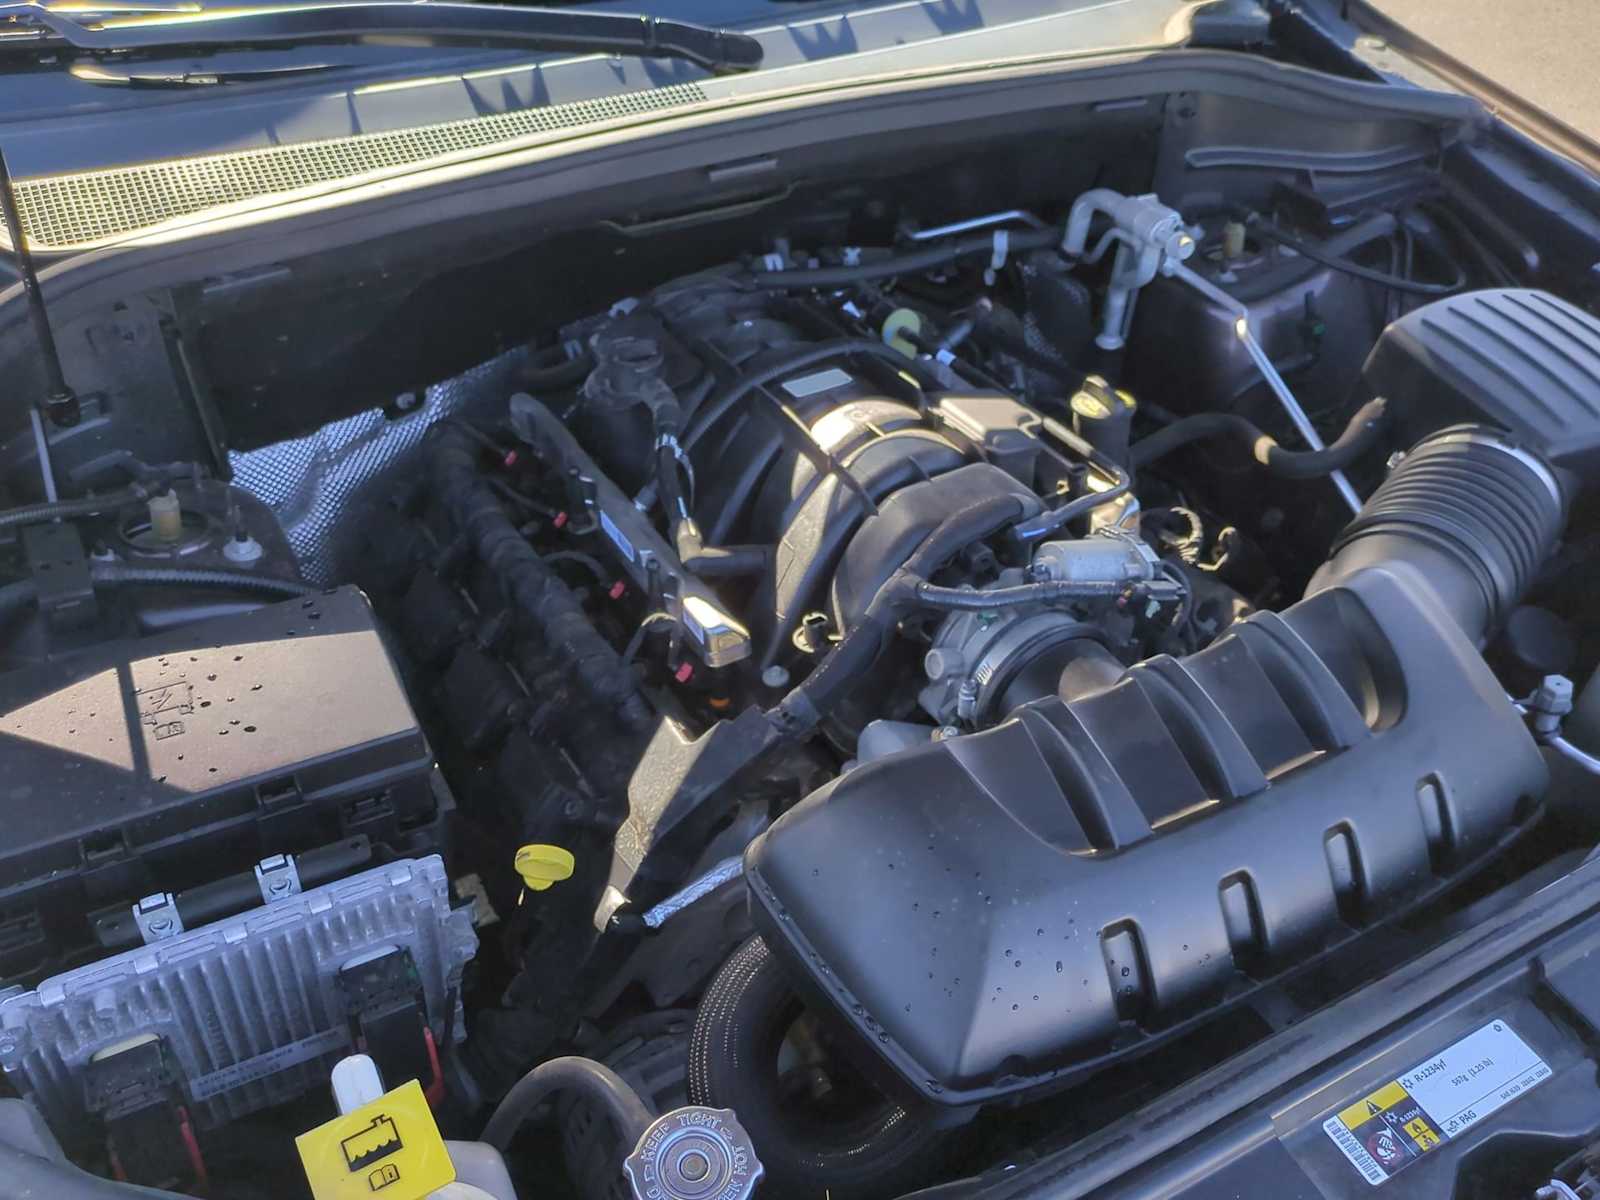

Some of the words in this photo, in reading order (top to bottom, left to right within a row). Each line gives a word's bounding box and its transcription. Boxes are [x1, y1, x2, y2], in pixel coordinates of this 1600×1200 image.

[1414, 1059, 1447, 1082] R-1234yf
[676, 1111, 722, 1127] TIGHT
[1459, 1110, 1477, 1125] PAG
[731, 1145, 748, 1176] HOT
